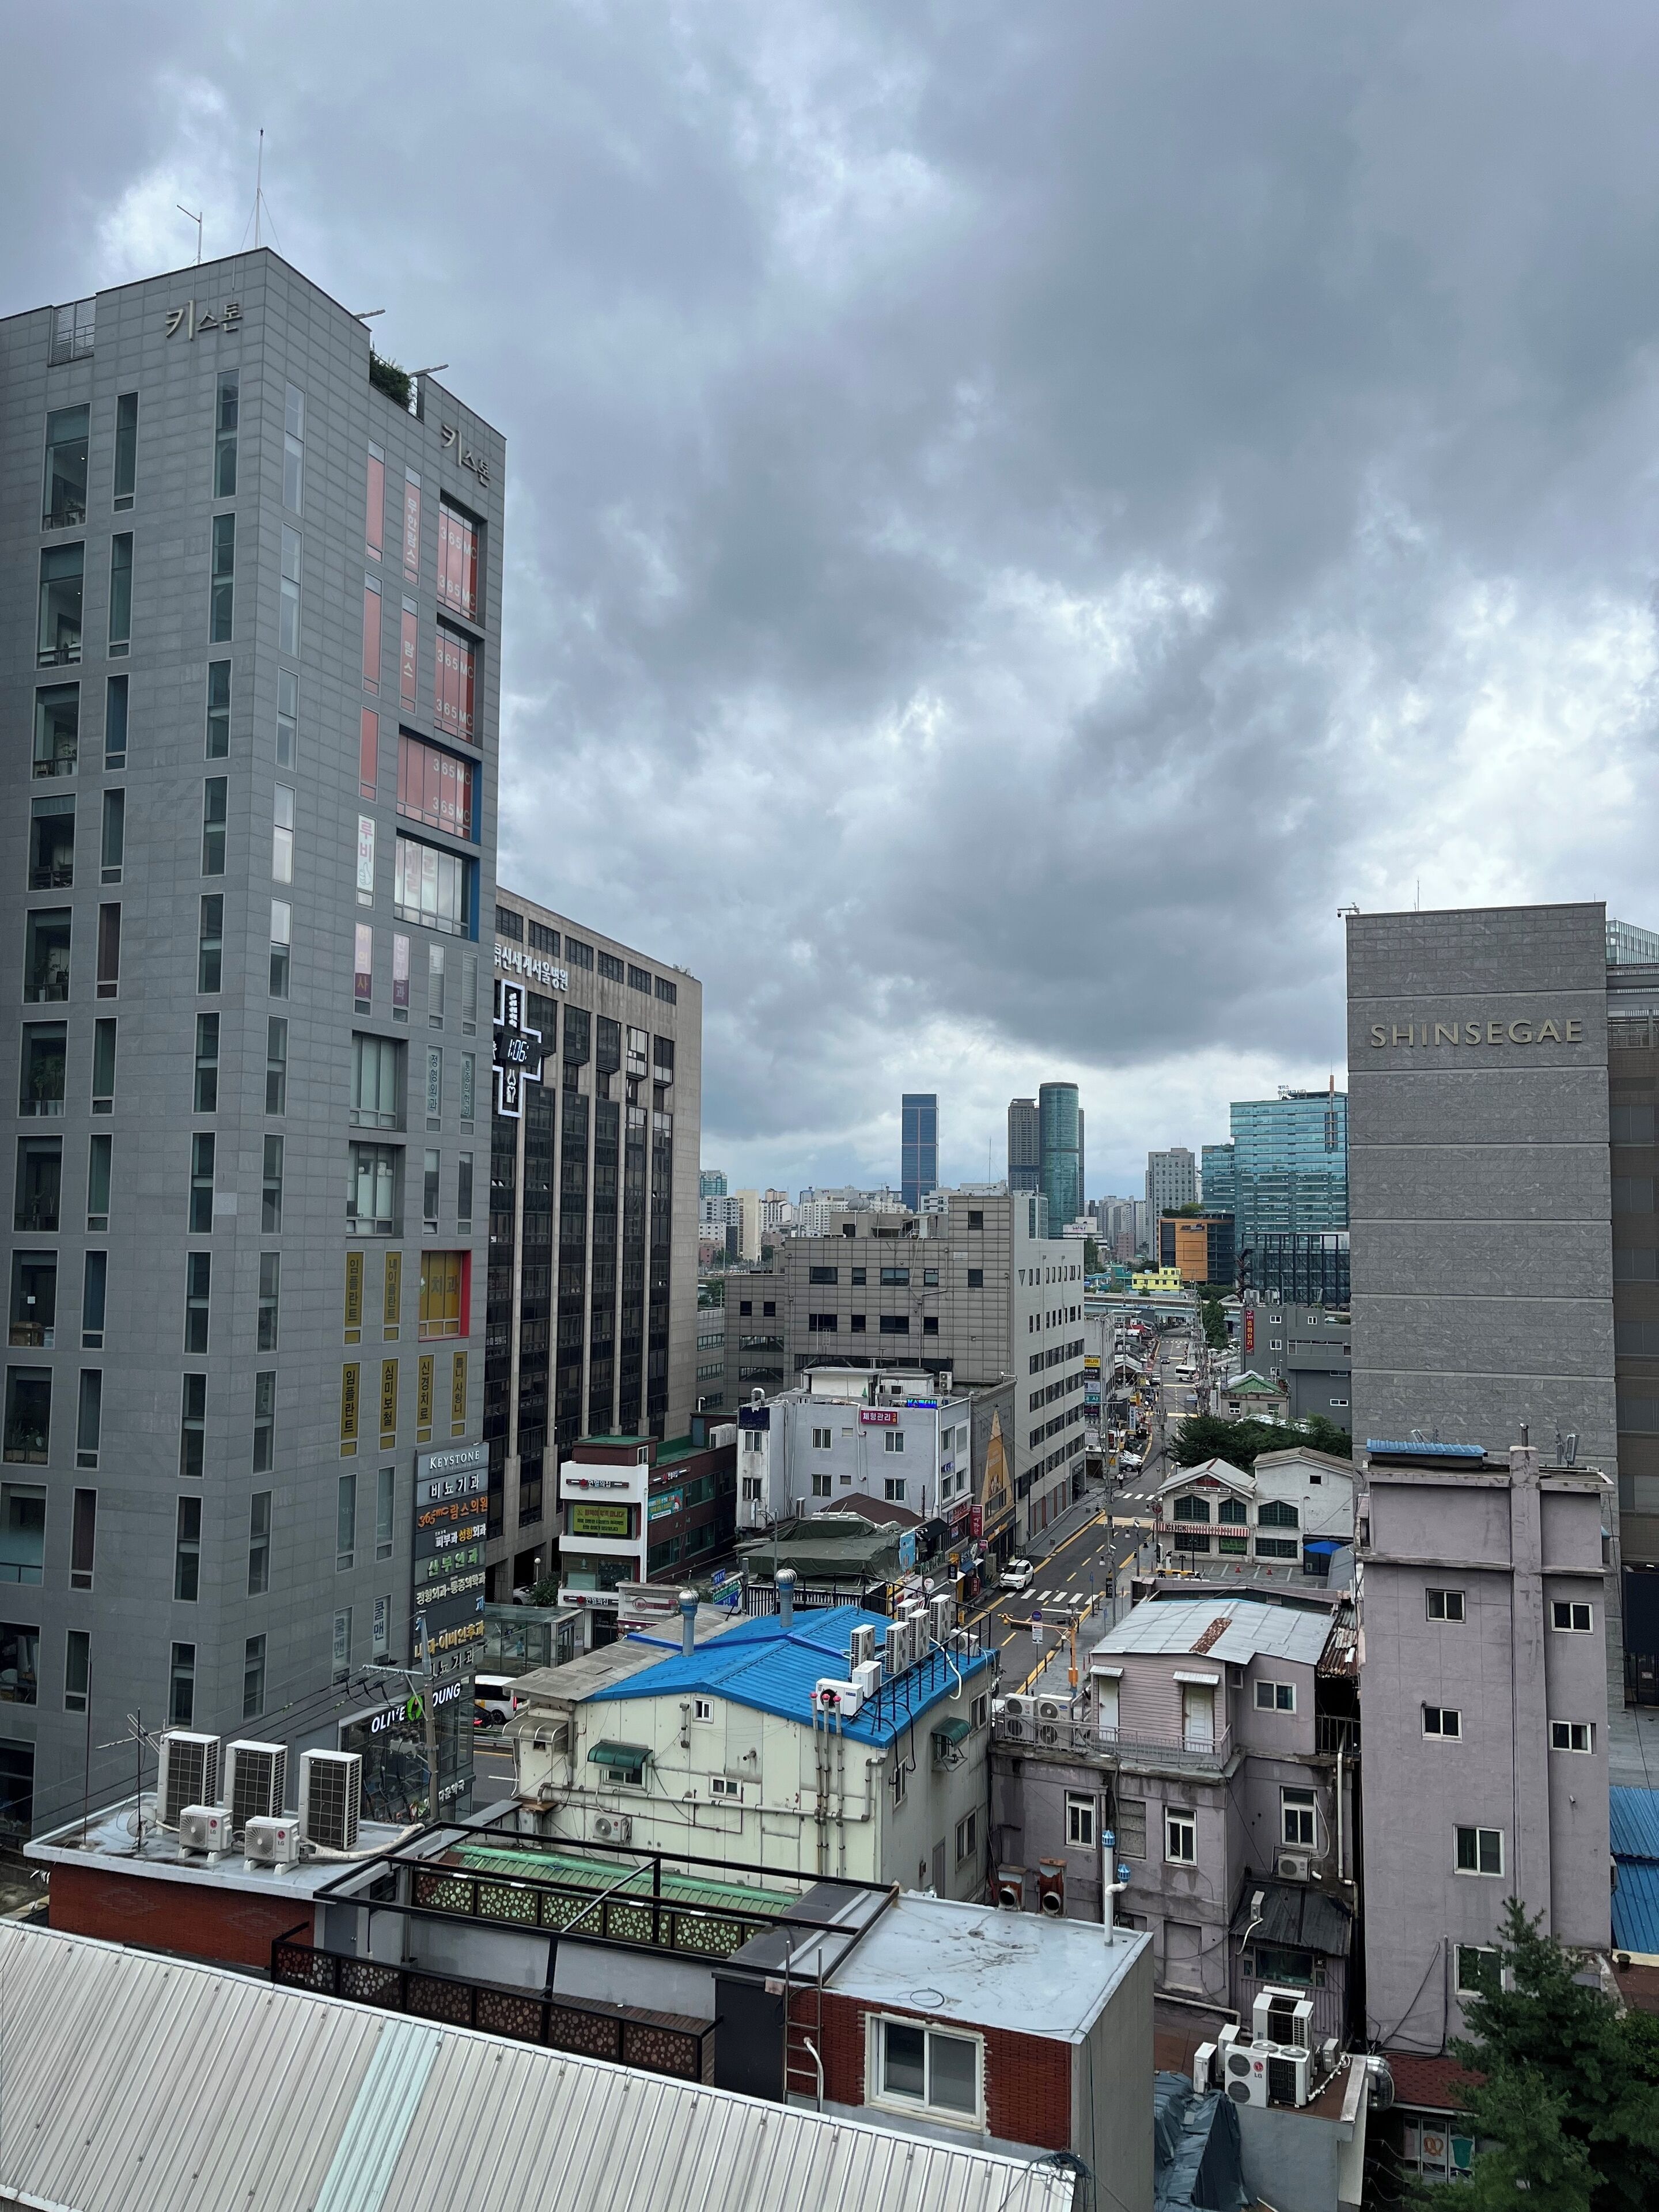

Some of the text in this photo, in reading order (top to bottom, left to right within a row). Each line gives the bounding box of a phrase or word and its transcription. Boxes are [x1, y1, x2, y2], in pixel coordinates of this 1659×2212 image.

[165, 300, 243, 341] 키스톤
[441, 425, 490, 487] 키스톤
[406, 498, 418, 565] 무한람스
[440, 526, 477, 559] 365MC
[440, 574, 476, 606] 365MC
[404, 641, 414, 677] 람스
[437, 649, 474, 679] 365MC
[436, 698, 473, 726] 365MC
[434, 758, 471, 785] 365MC
[433, 797, 471, 823] 365MC
[1371, 1018, 1582, 1047] SHINSEGAE
[429, 1055, 438, 1111] 정형외과
[348, 1259, 358, 1321] 임플란트
[431, 1275, 459, 1296] 치과
[344, 1370, 355, 1433] 임플란트
[384, 1365, 393, 1426] 심미보철
[420, 1361, 430, 1420] 신경치료
[863, 1412, 891, 1421] 체형관리
[429, 1450, 480, 1469] KEYSTONE
[431, 1474, 479, 1498] 비뇨기과
[428, 1548, 478, 1577] 산부인과
[374, 1601, 384, 1641] 쿨맨
[334, 1617, 344, 1659] 쿨맨
[433, 1683, 461, 1707] OUNG
